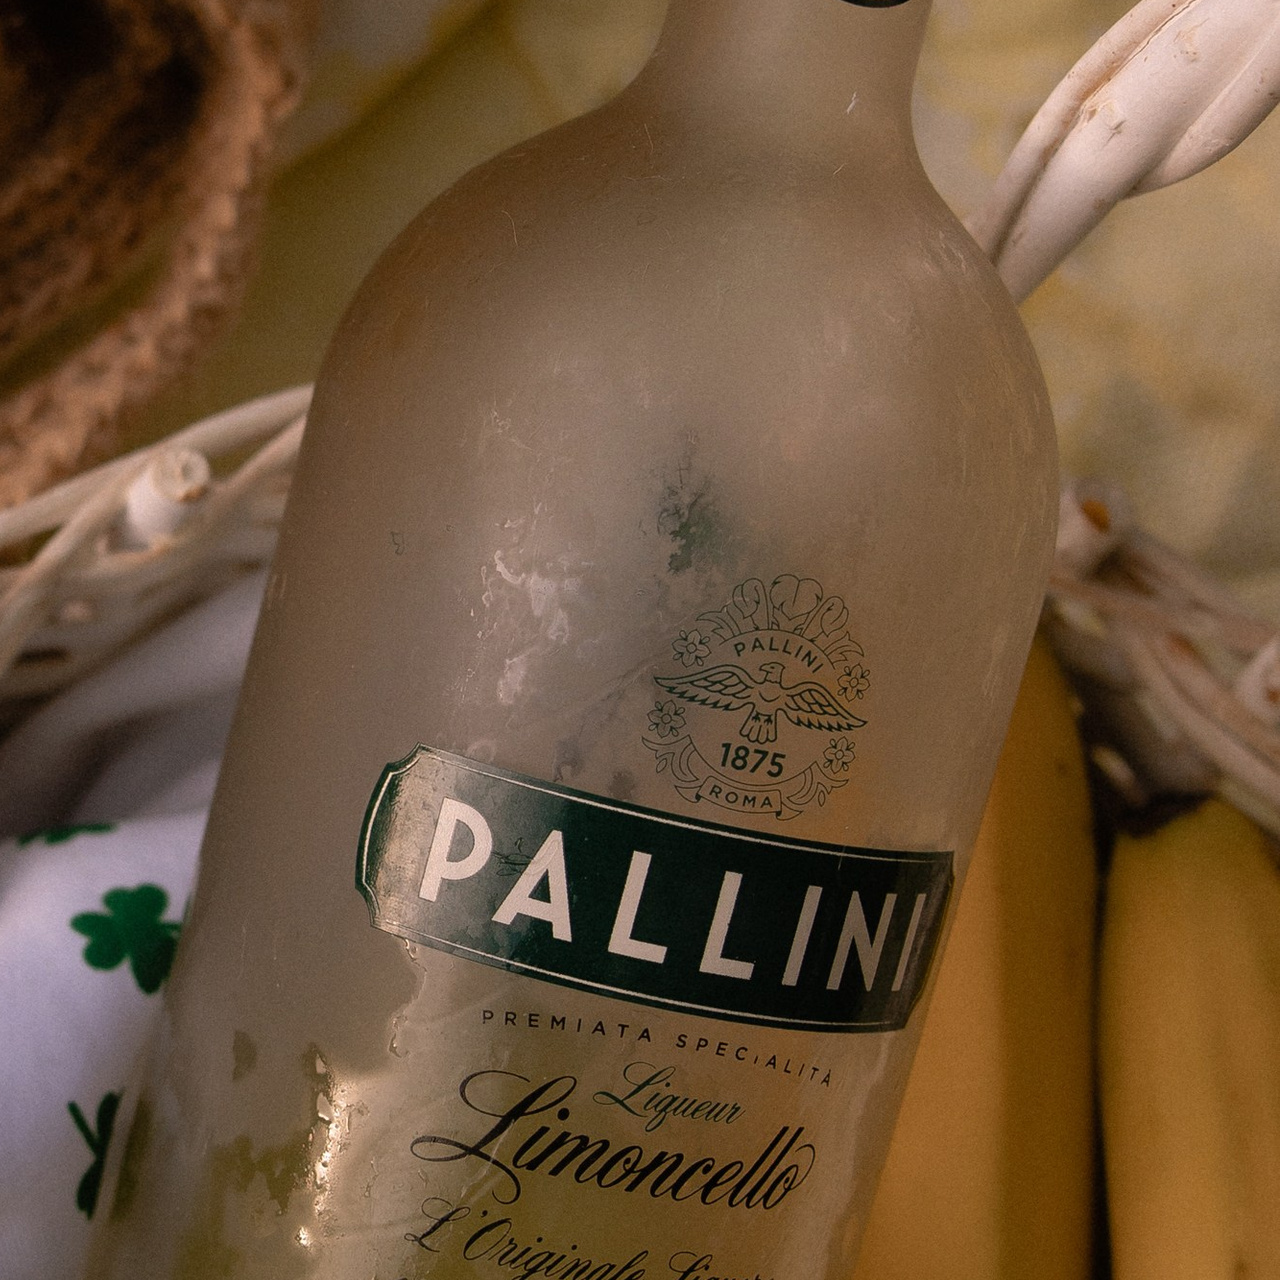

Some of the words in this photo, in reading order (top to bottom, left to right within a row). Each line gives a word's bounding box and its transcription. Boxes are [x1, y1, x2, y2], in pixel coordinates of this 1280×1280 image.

[732, 635, 825, 675] PALLINI
[708, 783, 774, 810] ROMA
[720, 741, 787, 779] 1875
[417, 796, 926, 992] PALLINI
[481, 1008, 652, 1043] PREMIATA
[675, 1032, 833, 1089] SPECIALITÀ
[592, 1060, 747, 1133] Liqueur
[410, 1069, 817, 1211] Limoncello
